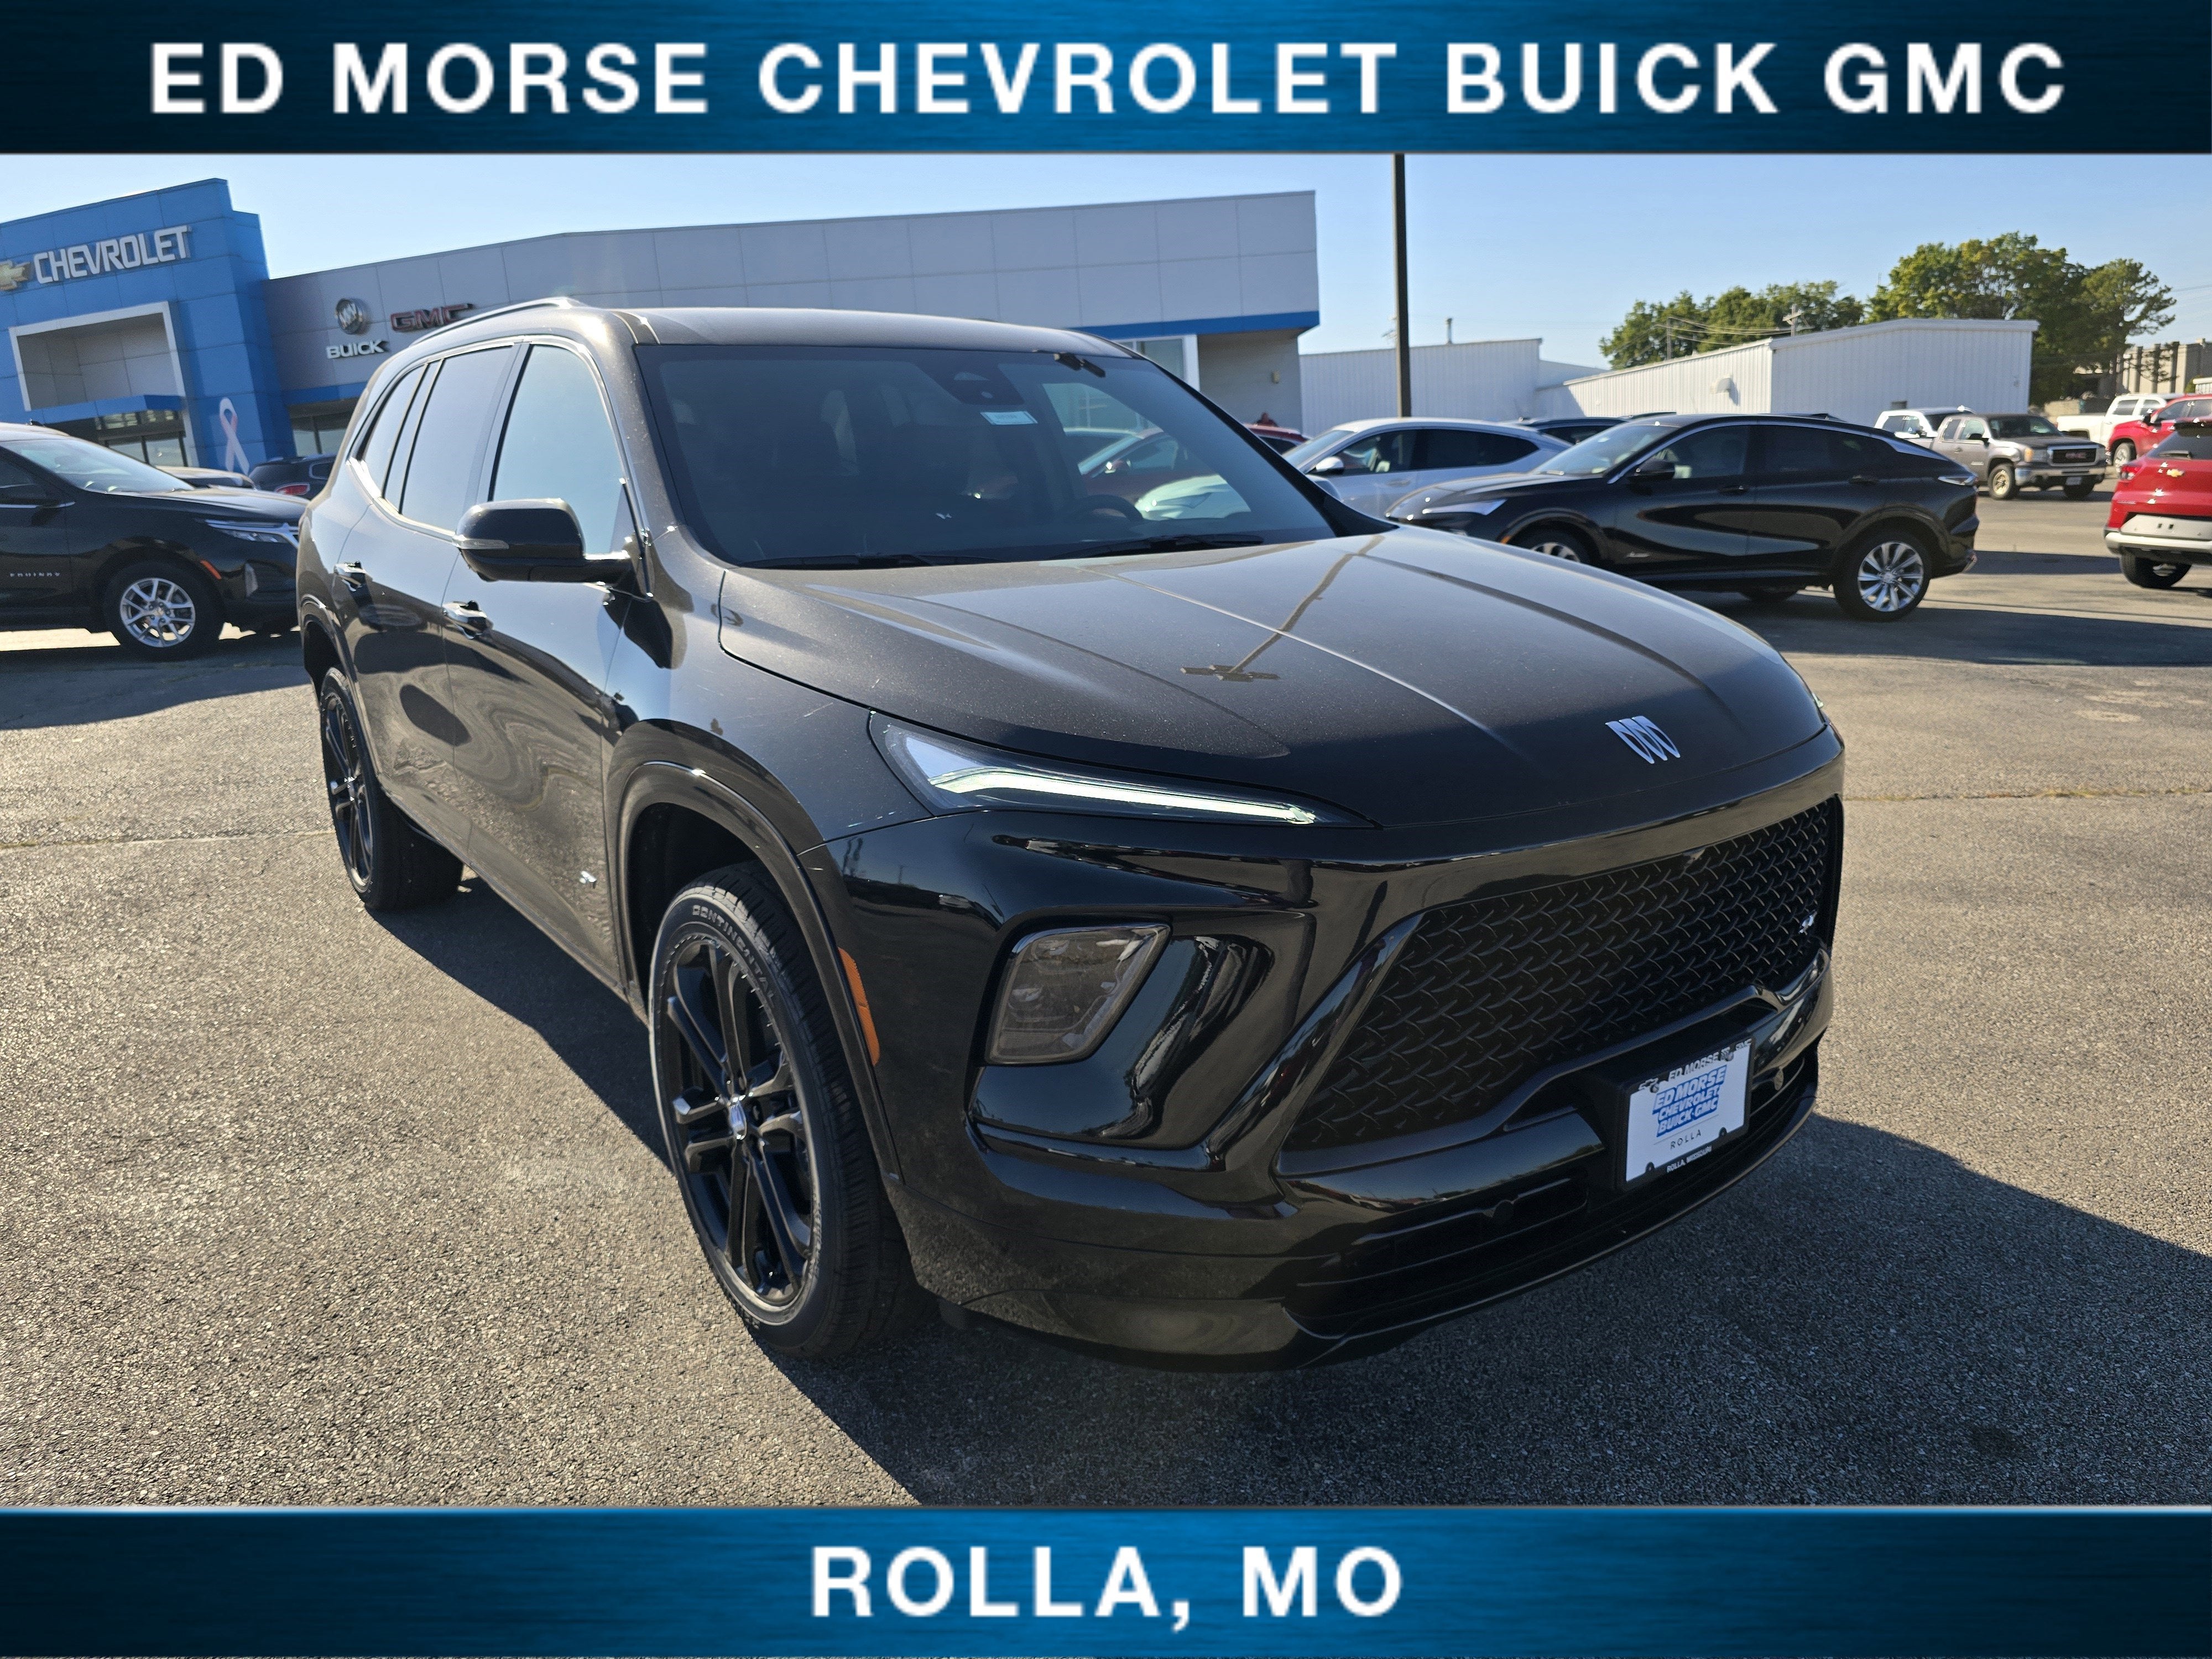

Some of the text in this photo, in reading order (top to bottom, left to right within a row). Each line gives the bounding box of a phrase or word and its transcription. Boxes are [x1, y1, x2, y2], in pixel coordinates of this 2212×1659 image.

[34, 225, 189, 284] CHEVROLET
[390, 304, 468, 331] GMC
[326, 340, 386, 359] BUICK
[692, 904, 775, 1003] CONTINENTAL
[1653, 1065, 1726, 1113] ED MORSE
[1658, 1085, 1720, 1121] CHEVROLET
[1657, 1108, 1693, 1135] BUICK
[1670, 1129, 1701, 1150] ROLLA
